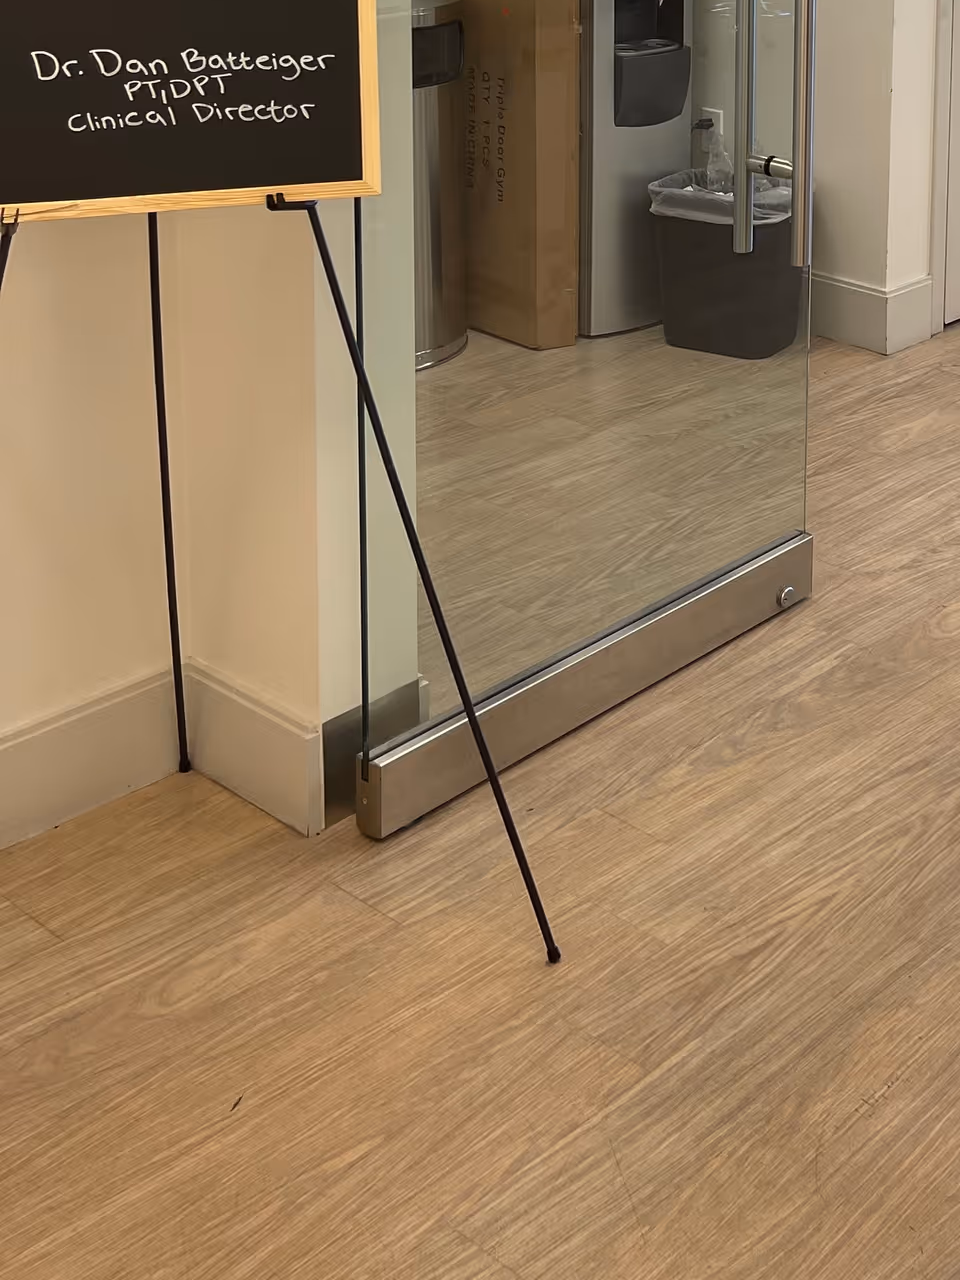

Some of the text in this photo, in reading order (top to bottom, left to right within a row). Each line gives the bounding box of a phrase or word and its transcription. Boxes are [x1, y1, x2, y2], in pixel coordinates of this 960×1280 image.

[30, 47, 336, 81] Dr. Dan Batteiger
[481, 71, 491, 105] QTY
[67, 100, 316, 133] Clinical Director
[481, 135, 491, 168] PCS
[495, 77, 507, 202] Triple Door Gym
